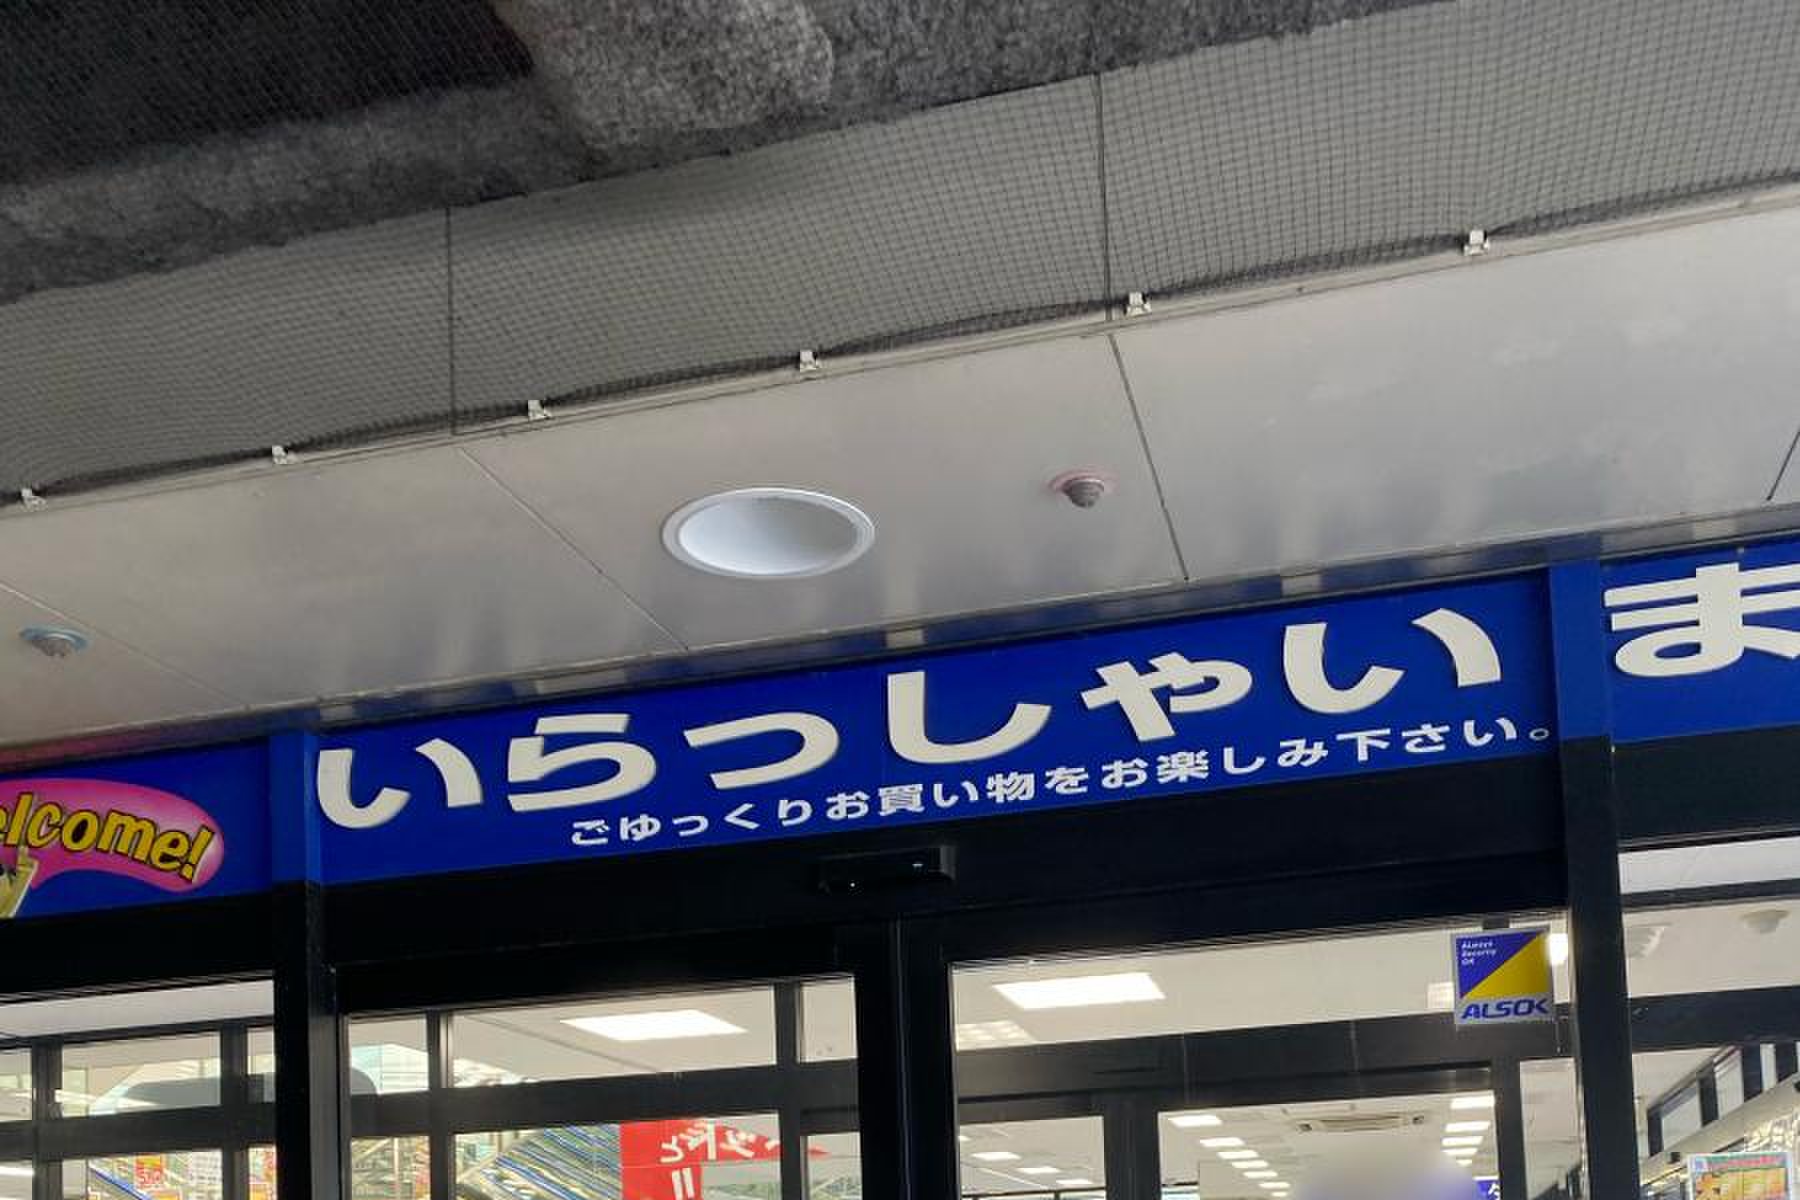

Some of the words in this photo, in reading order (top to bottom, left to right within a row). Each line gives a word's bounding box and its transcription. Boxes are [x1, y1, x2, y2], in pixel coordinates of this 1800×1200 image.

[571, 717, 1550, 846] ごゆっくりお買い物をお楽しみ下さい。
[0, 792, 215, 884] lcome!
[1461, 998, 1549, 1020] ALSOK
